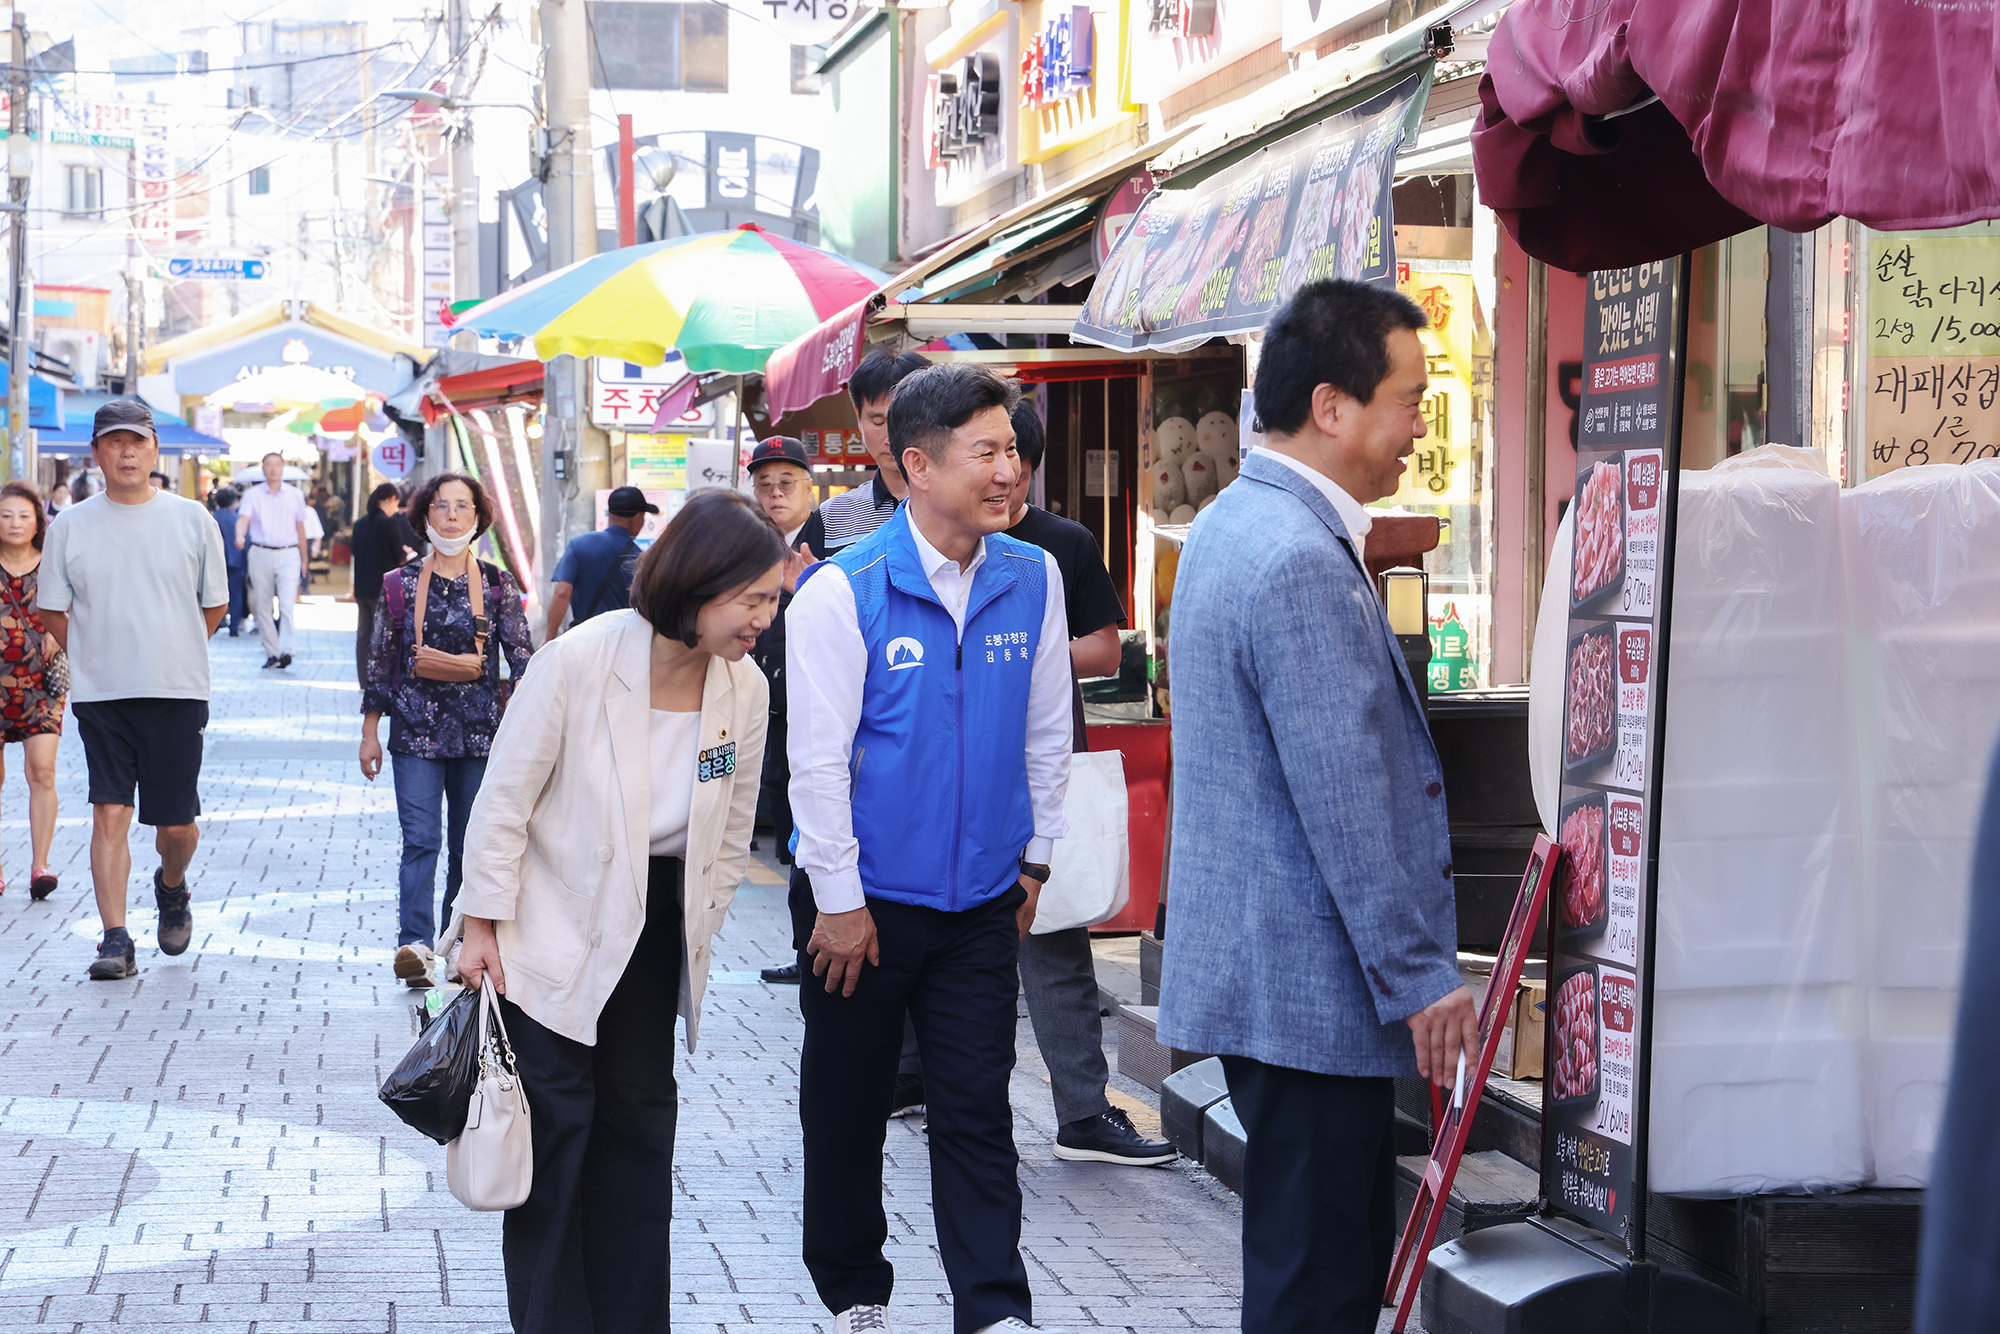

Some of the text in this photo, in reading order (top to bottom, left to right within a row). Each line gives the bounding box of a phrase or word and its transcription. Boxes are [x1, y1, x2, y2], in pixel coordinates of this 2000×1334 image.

[1876, 244, 1918, 282] 순살
[1416, 285, 1451, 329] 秀
[1599, 292, 1660, 355] 맛있는 선택!
[1594, 367, 1605, 389] 좋은
[1604, 365, 1620, 387] 고기는
[382, 443, 406, 472] 떡
[985, 631, 1029, 647] 도봉구청장
[1626, 636, 1646, 661] 우삼겹살
[1428, 665, 1449, 690] 생
[707, 743, 735, 760] 서울시의원
[700, 753, 735, 781] 홍은정
[1603, 980, 1618, 1004] 초이스
[1614, 1010, 1625, 1029] 600g
[1556, 1132, 1566, 1162] 오늘
[1578, 1140, 1594, 1173] 맛있는
[1594, 1147, 1610, 1177] 고기로
[1562, 1170, 1579, 1205] 행복을
